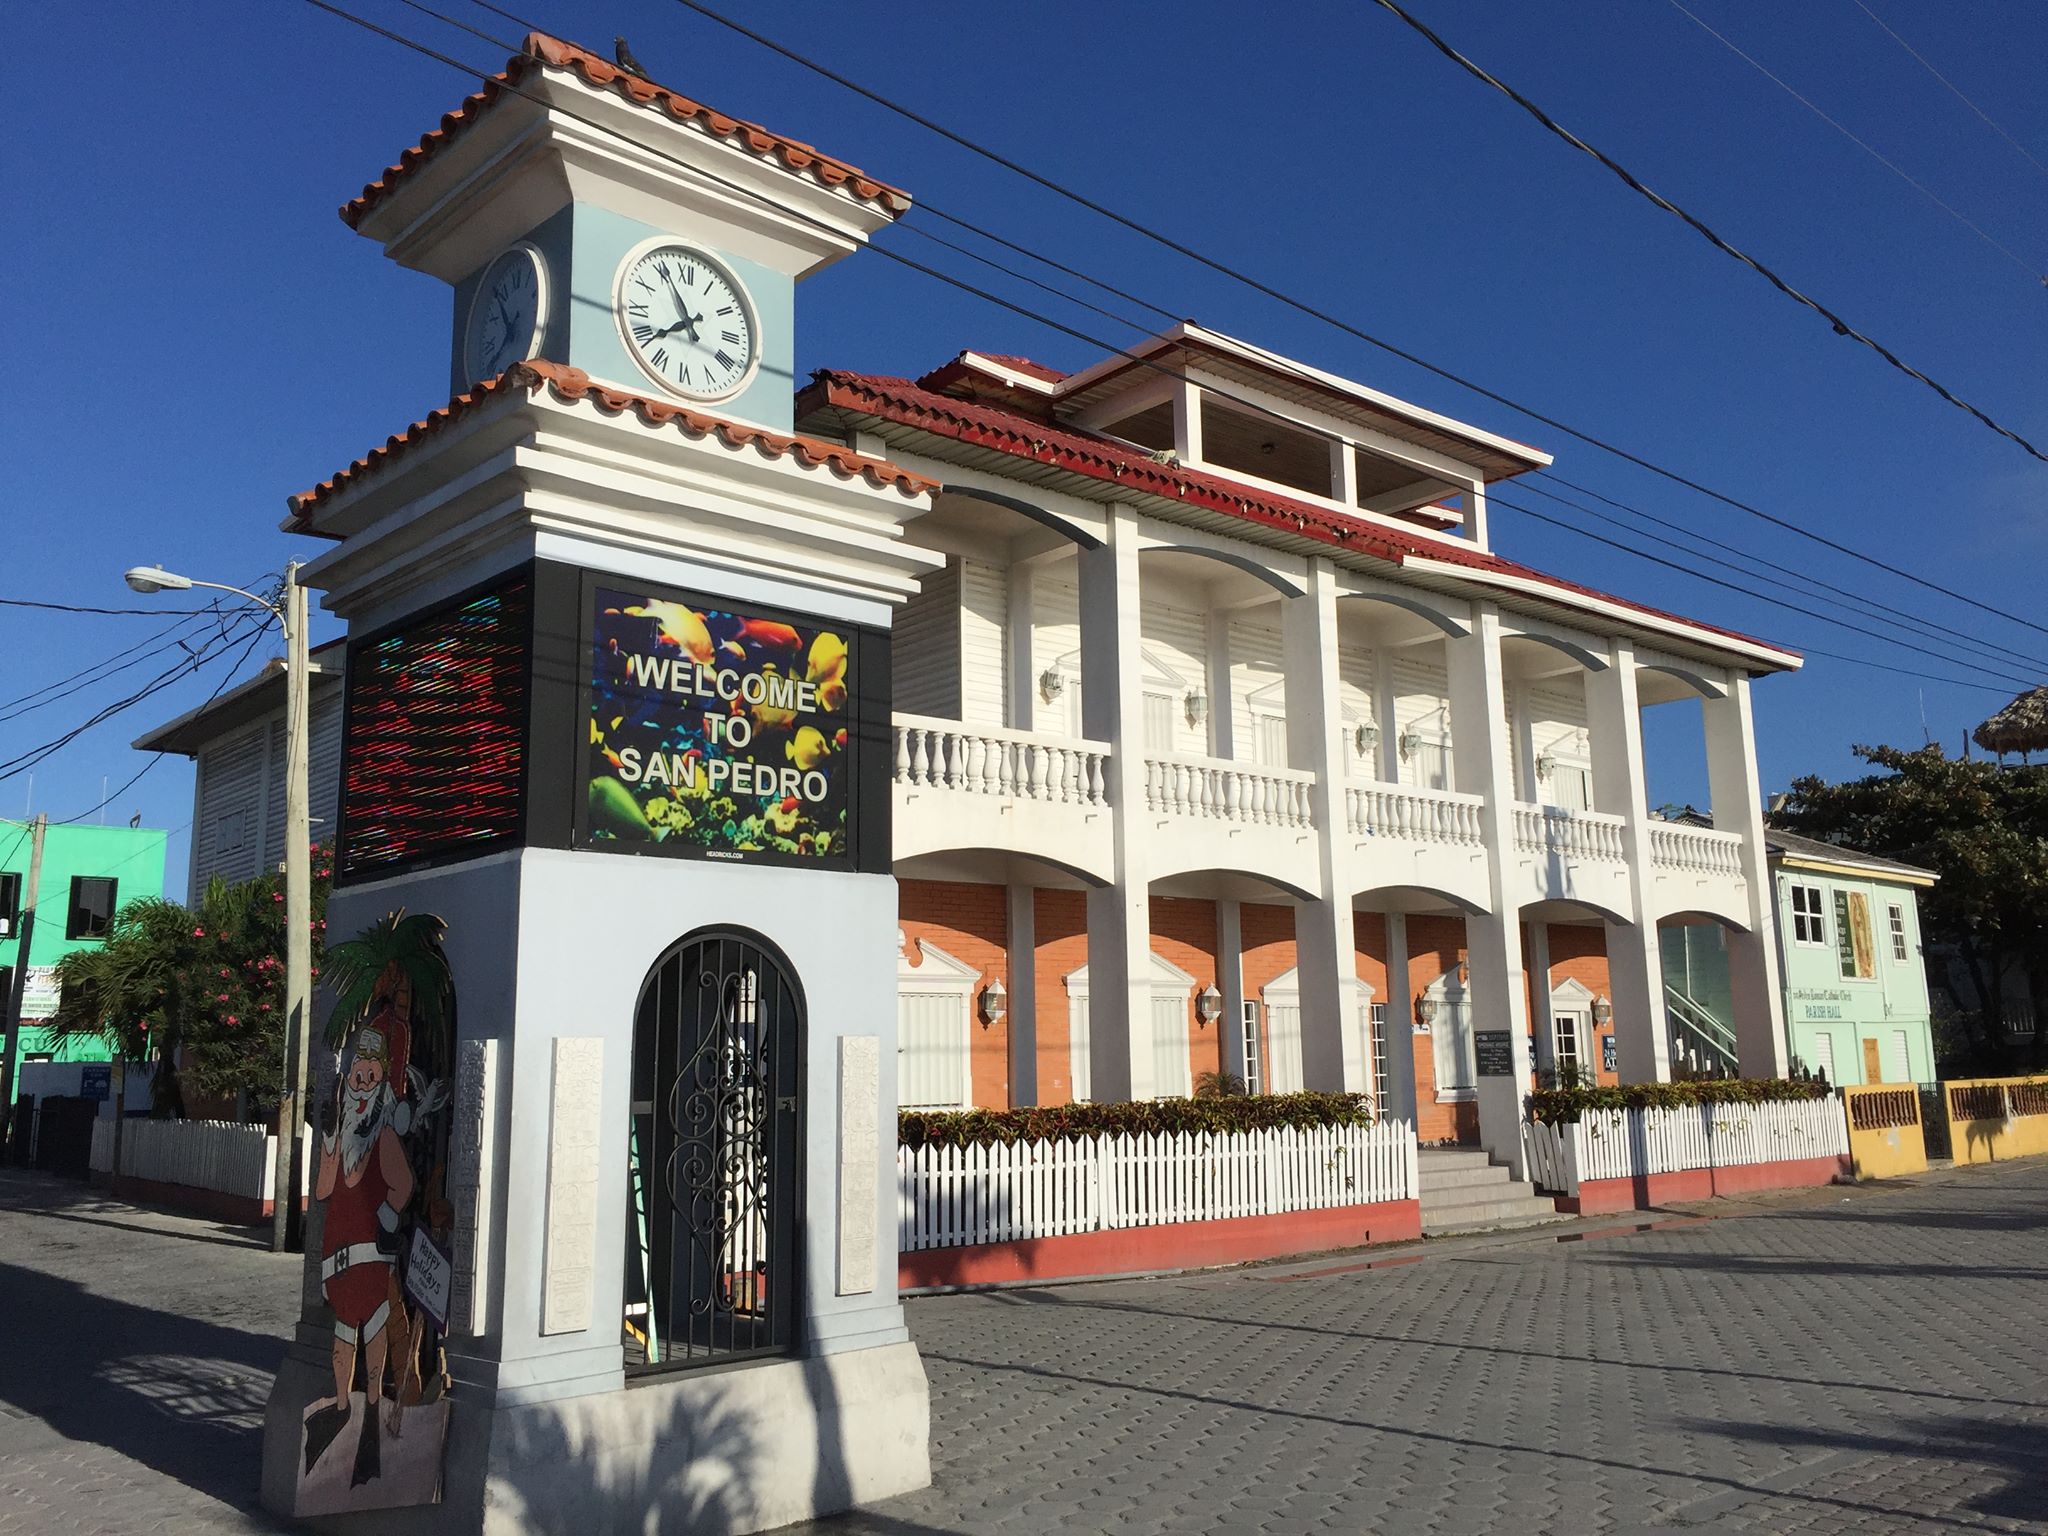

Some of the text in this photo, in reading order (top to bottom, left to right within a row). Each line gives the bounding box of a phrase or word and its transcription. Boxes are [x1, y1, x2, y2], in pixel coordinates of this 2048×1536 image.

[633, 654, 817, 713] WELCOME
[704, 711, 752, 748] TO
[618, 747, 829, 802] SAN PEDRO
[410, 1253, 441, 1295] Holidays
[419, 1238, 441, 1271] Happy
